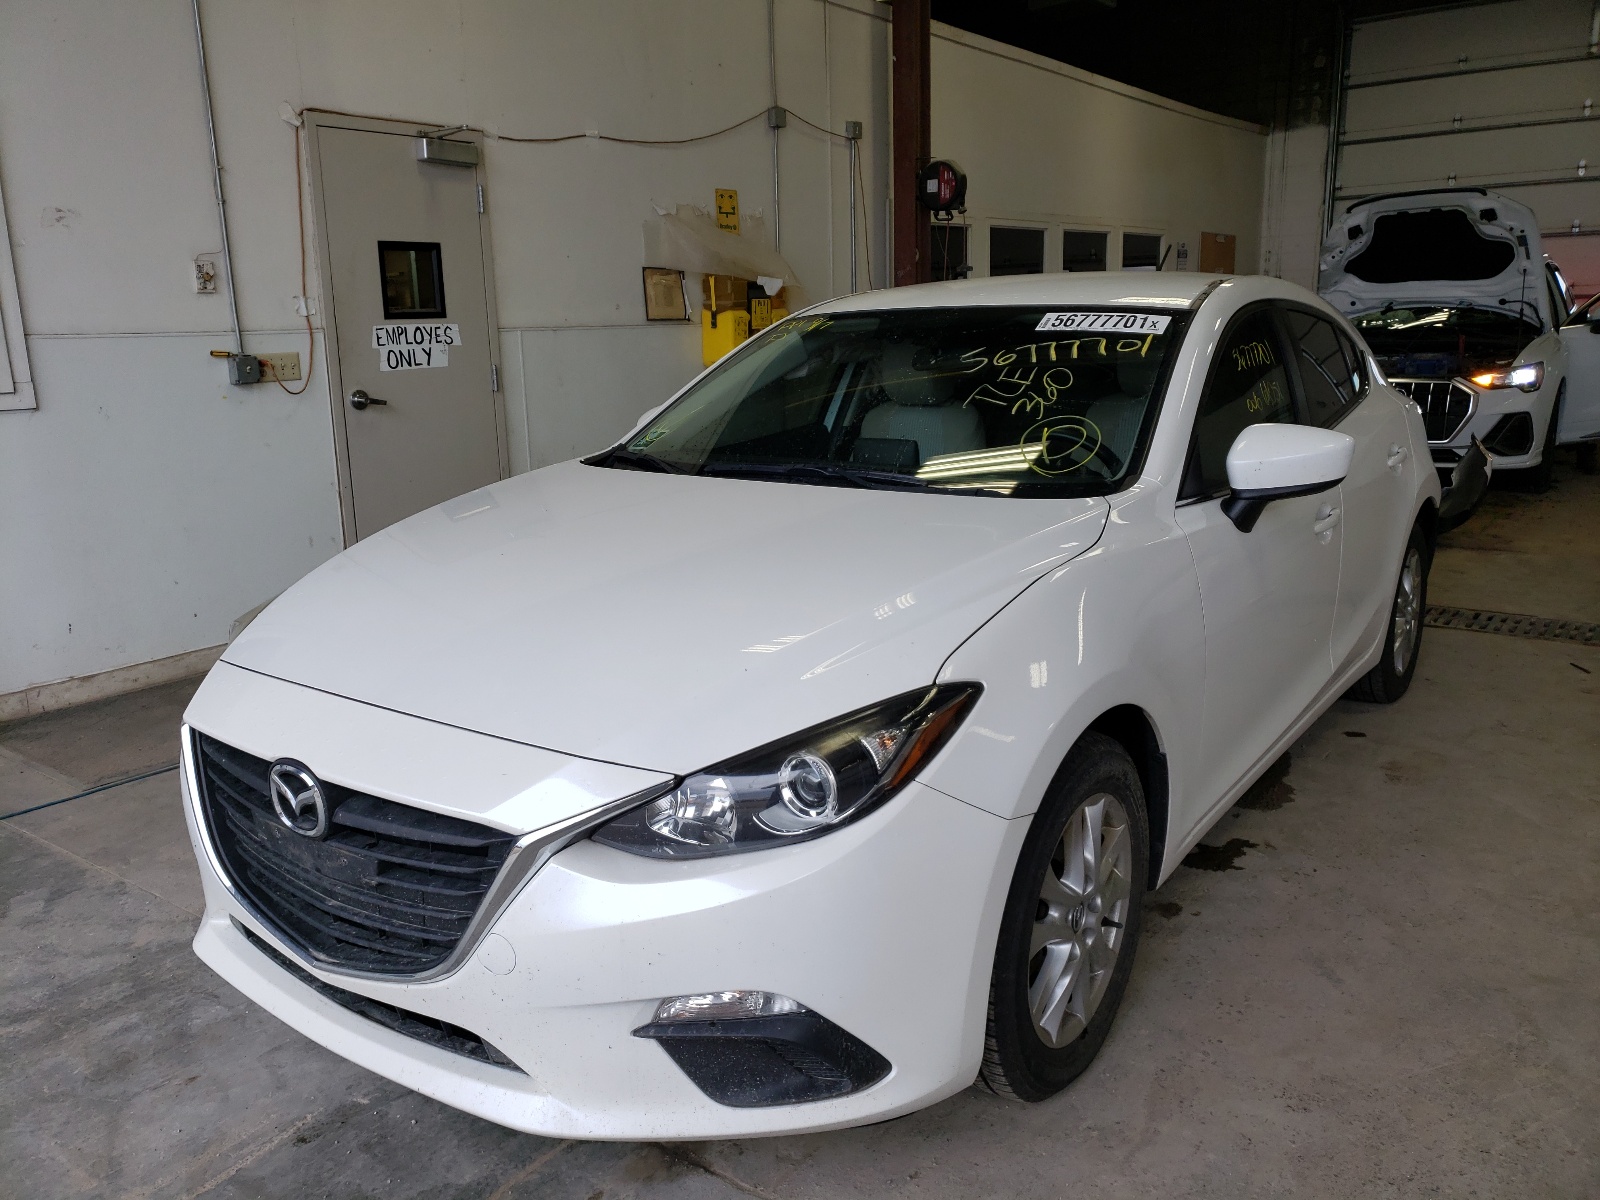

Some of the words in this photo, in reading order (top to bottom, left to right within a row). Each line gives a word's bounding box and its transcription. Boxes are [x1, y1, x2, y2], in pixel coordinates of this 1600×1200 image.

[1051, 314, 1149, 329] 56777701
[375, 325, 454, 347] EMPLOYES
[386, 346, 432, 370] ONLY
[960, 334, 1154, 372] 56777701
